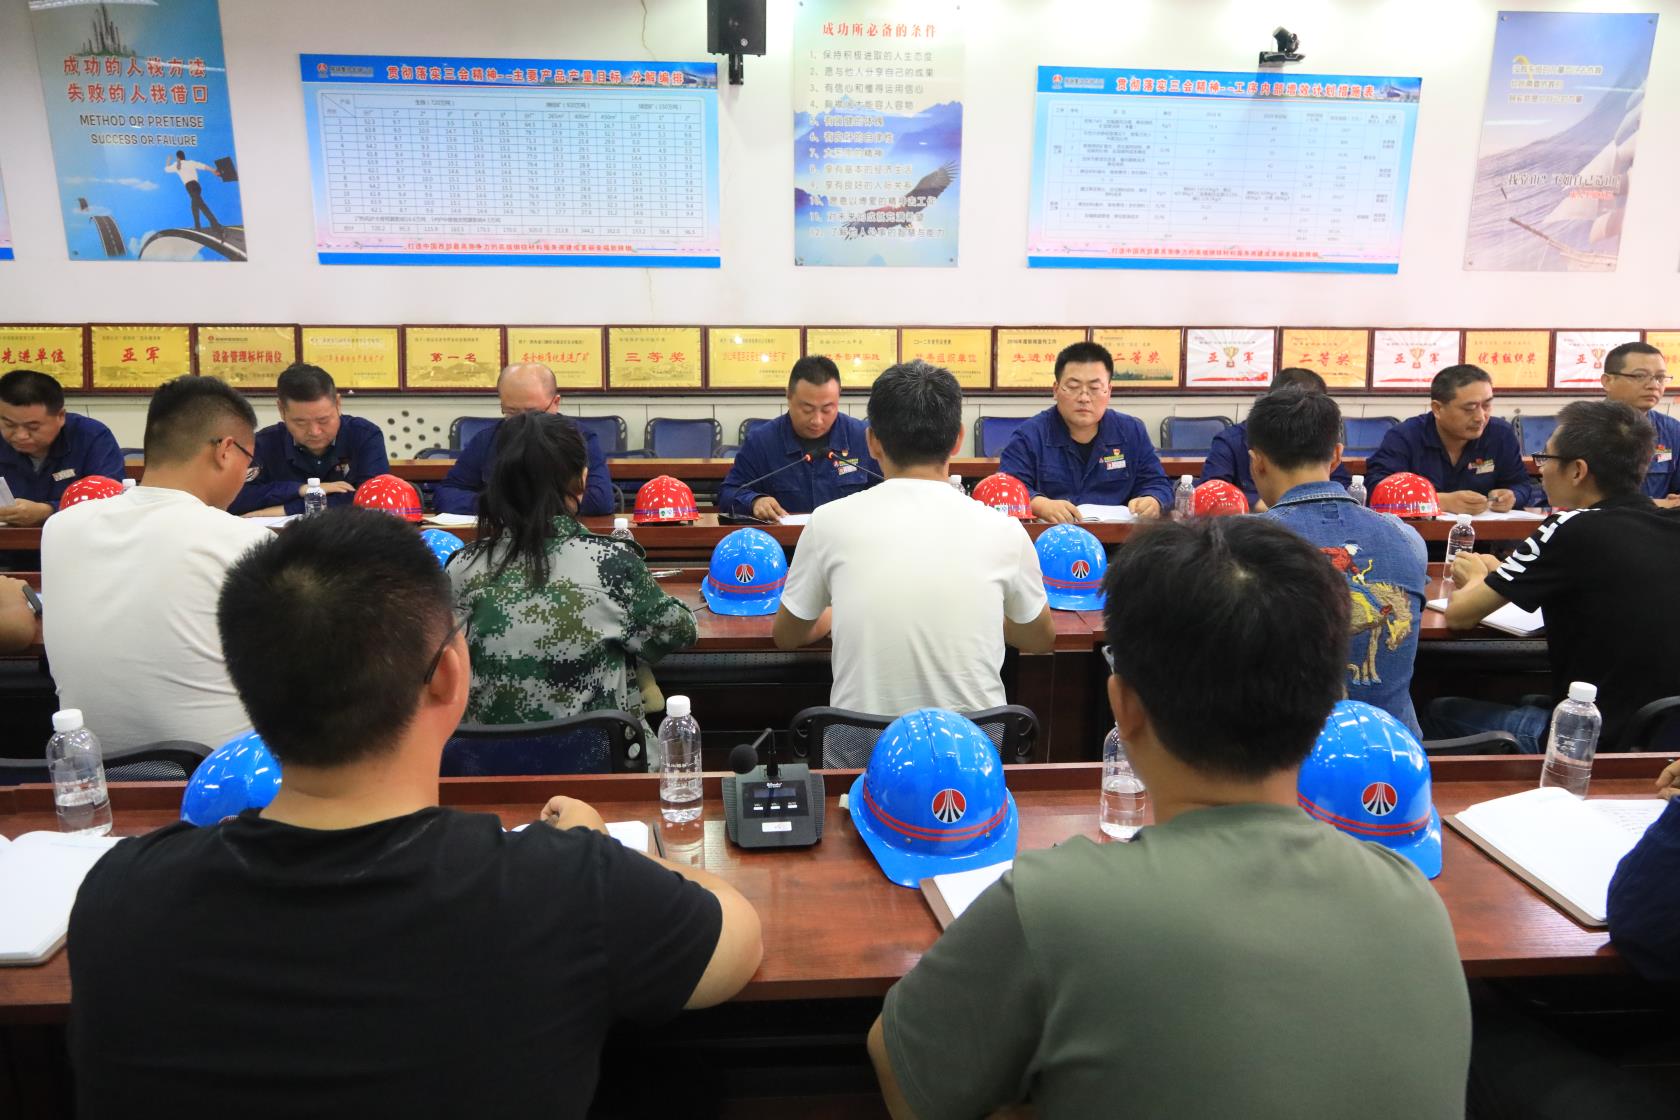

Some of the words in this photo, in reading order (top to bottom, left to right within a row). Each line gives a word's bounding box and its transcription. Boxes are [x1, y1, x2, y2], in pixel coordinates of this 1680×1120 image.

[823, 22, 937, 38] 成功所必备的条件
[63, 56, 207, 77] 成功的人找方法
[67, 84, 209, 103] 失败的人找借口
[80, 114, 125, 127] METHOD
[129, 116, 144, 127] OR
[148, 115, 204, 128] PRETENSE
[91, 134, 138, 145] SUCCESS
[140, 135, 154, 145] OR
[156, 135, 197, 146] FAILURE
[1, 347, 66, 365] 先进单位
[121, 346, 161, 365] 亚军
[212, 350, 283, 363] 设备管理标杆岗位
[430, 352, 478, 364] 第一名
[624, 351, 686, 364] 三等奖
[1112, 350, 1161, 366] 二等奖
[1299, 352, 1351, 367] 二等奖
[1477, 352, 1537, 365] 优秀组织奖
